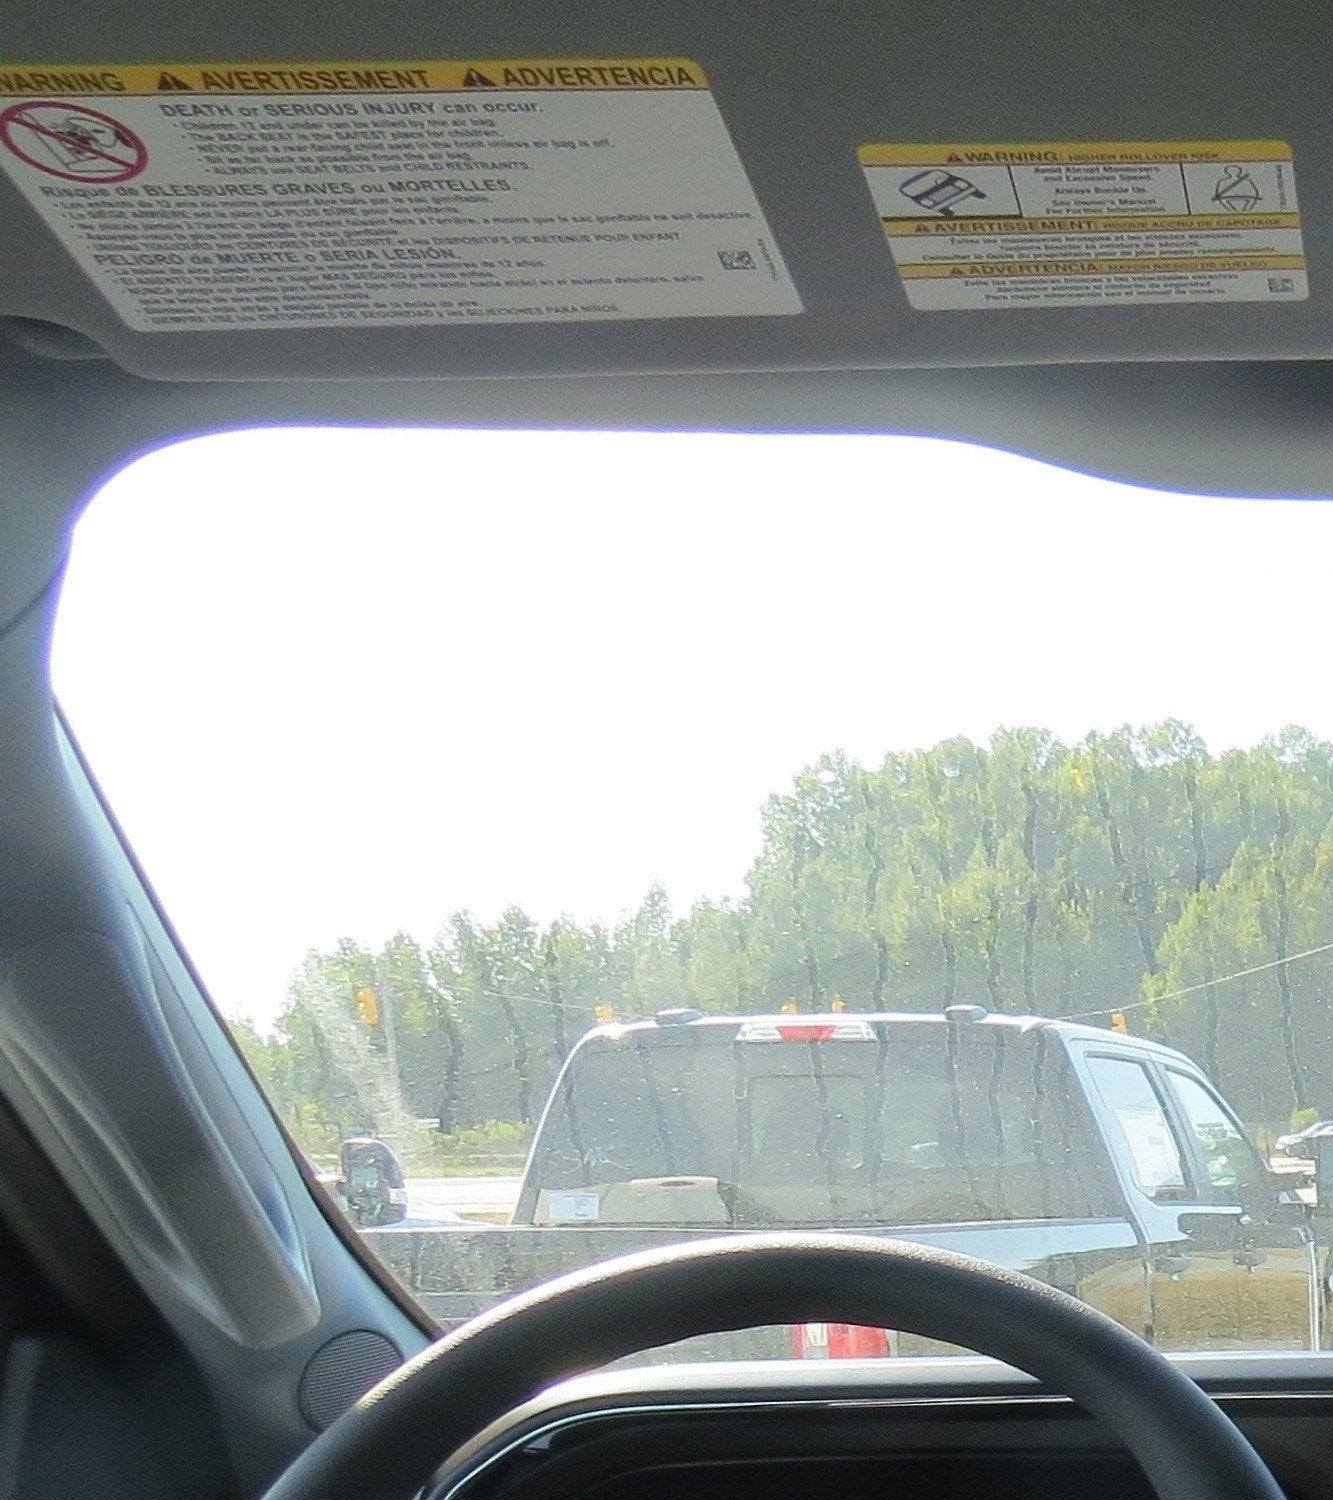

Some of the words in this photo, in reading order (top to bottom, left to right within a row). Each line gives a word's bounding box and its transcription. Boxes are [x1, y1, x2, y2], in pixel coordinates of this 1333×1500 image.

[200, 70, 431, 91] AVERTISSEMENT
[500, 66, 696, 86] ADVERTENCIA
[160, 103, 235, 117] DEATH
[238, 106, 259, 117] or
[263, 103, 358, 116] SERIOUS
[362, 101, 437, 115] INJURY
[443, 103, 477, 114] can
[42, 185, 110, 199] Risque
[116, 185, 140, 197] de
[143, 183, 268, 197] BLESSURES
[272, 182, 356, 195] GRAVES
[361, 183, 385, 193] ou
[93, 253, 185, 266] PELIGRO
[217, 252, 300, 264] MUERTE
[318, 249, 381, 262] SERIA
